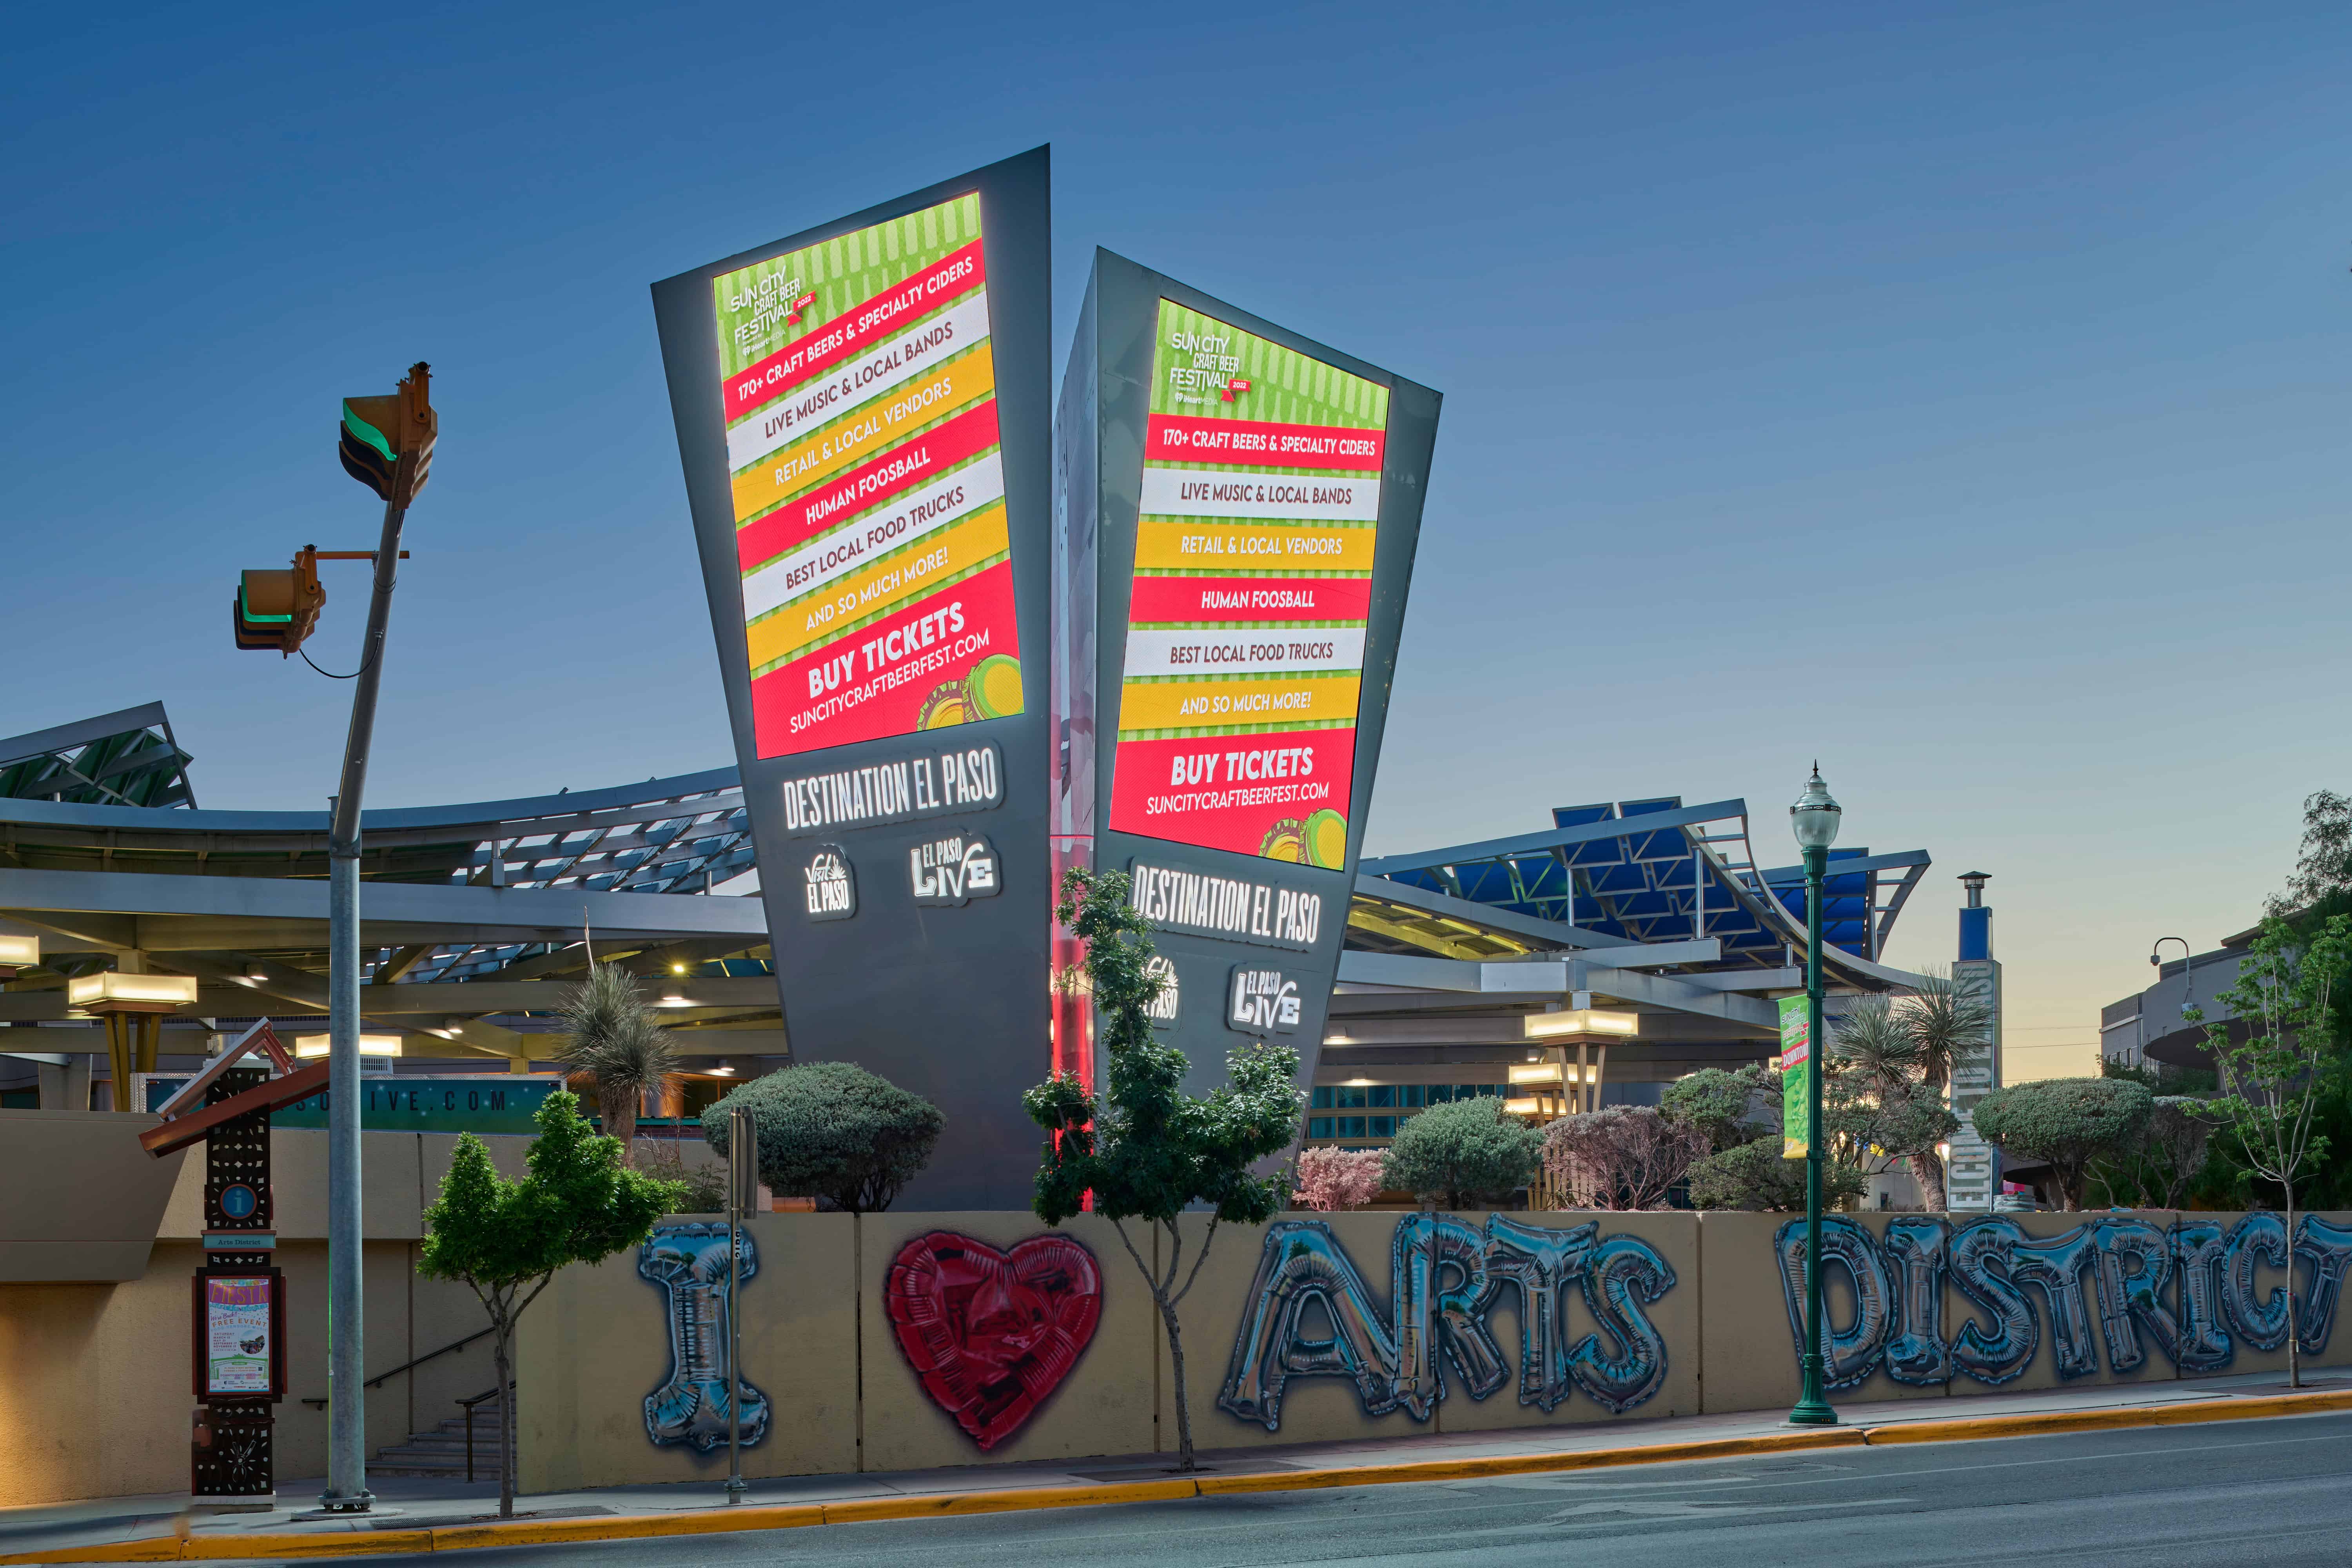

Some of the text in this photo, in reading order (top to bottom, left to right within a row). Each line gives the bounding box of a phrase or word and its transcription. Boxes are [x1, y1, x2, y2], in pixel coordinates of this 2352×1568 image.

[731, 265, 786, 312] SUN CITY
[754, 278, 800, 316] CRAFT BEER
[735, 295, 811, 345] FESTIVAL 2022
[739, 256, 973, 401] 170+ CRAFT BEERS & SPECIALTY CIDERS
[1172, 331, 1230, 356] SUN CITY
[766, 322, 953, 439] LIVE MUSIC & LOCAL BANDS
[1169, 367, 1228, 391] FESTIVAL
[1194, 352, 1239, 378] CRAFT BEER
[775, 377, 952, 487] RETAIL & LOCAL VENDORS
[1163, 429, 1376, 456] 170+ CRAFT BEERS & SPECIALTY CIDERS
[806, 447, 931, 525] HUMAN FOOSBALL
[1181, 483, 1352, 505] LIVE MUSIC & LOCAL BANDS
[786, 486, 964, 590] BEST LOCAL FOOD TRUCKS
[1181, 536, 1343, 555] RETAIL & LOCAL VENDORS
[806, 546, 949, 632] AND SO MUCH MORE!
[1201, 590, 1315, 609] HUMAN FOOSBALL
[808, 602, 965, 699] BUY TICKETS
[1170, 642, 1333, 664] BEST LOCAL FOOD TRUCKS
[790, 628, 990, 733] SUNCITYCRAFTBEERFEST.COM
[1180, 691, 1312, 715] AND SO MUCH MORE!
[1171, 747, 1314, 786] BUY TICKETS
[784, 748, 997, 829] DESTINATION EL PASO
[1146, 782, 1329, 815] SUNCITYCRAFTBEERFEST.COM
[805, 854, 831, 883] Visit
[923, 837, 962, 867] EL PASO
[911, 843, 993, 897] LIVE
[808, 880, 849, 913] EL PASO
[1132, 865, 1320, 943] DESTINATION EL PASO
[1247, 971, 1281, 995] EL PASO
[1234, 973, 1300, 1029] LIVE
[1781, 1012, 1790, 1024] SUN
[1791, 1005, 1800, 1018] CITY
[1782, 1022, 1802, 1041] FESTIVAL
[1950, 1107, 1991, 1212] ELCOME
[211, 1285, 267, 1304] FIESTA
[212, 1319, 267, 1328] FREE EVENT
[1219, 1213, 1675, 1430] ARTS
[1773, 1212, 2352, 1390] DISTRICT
